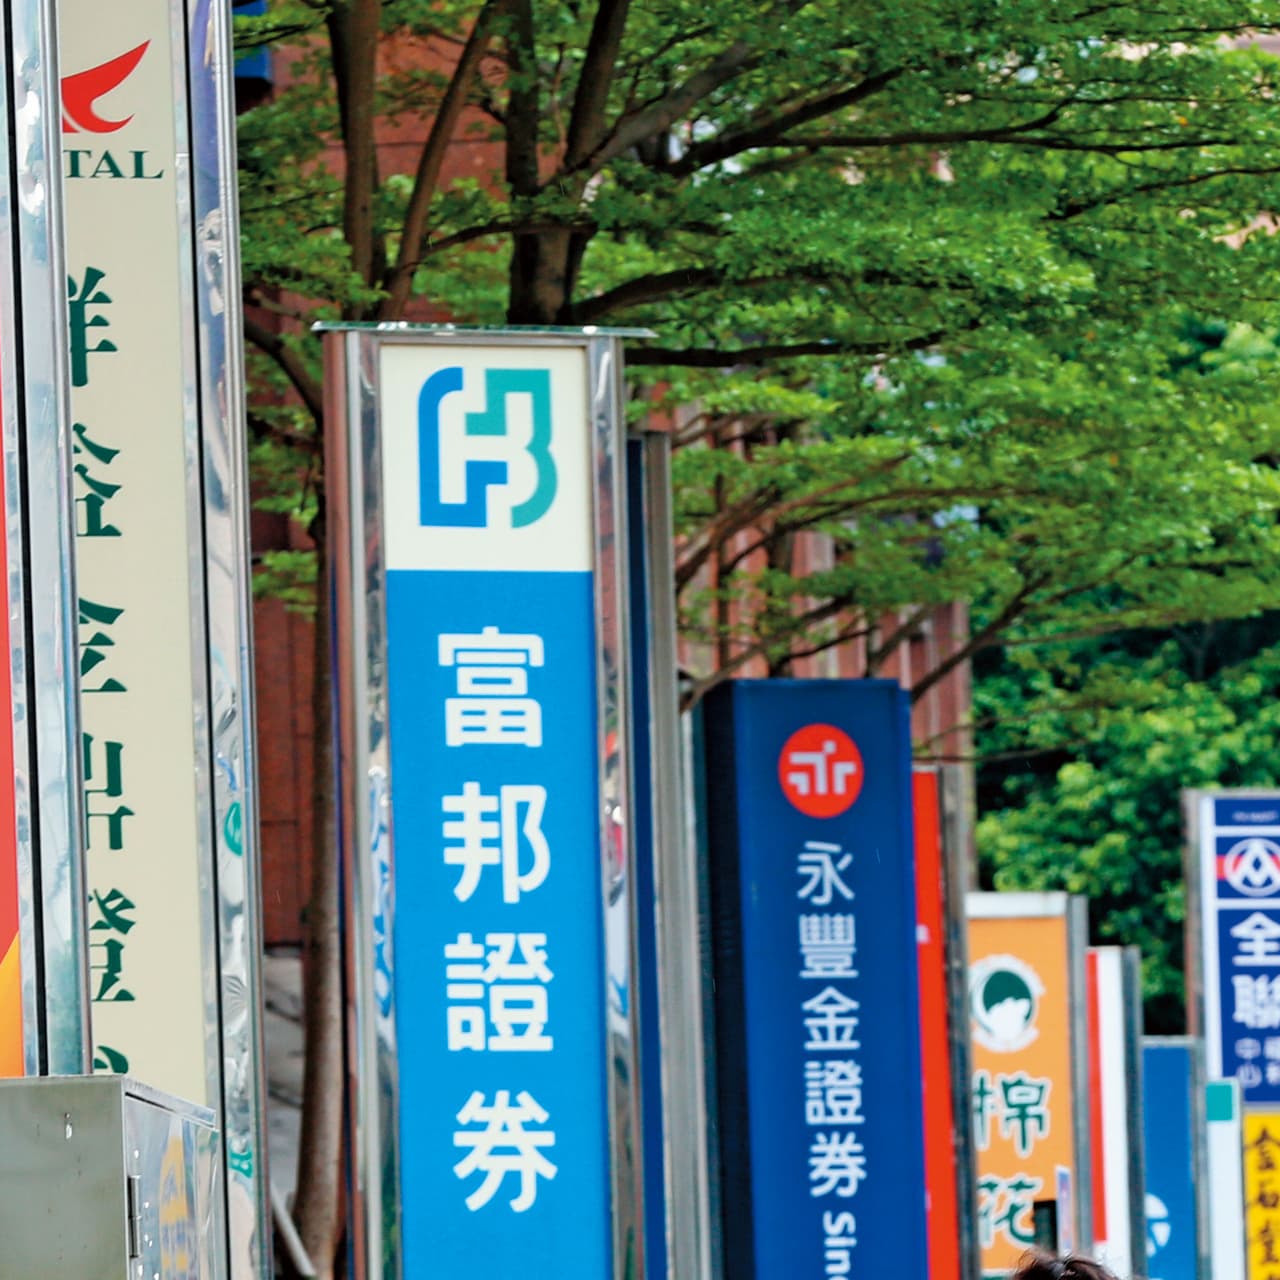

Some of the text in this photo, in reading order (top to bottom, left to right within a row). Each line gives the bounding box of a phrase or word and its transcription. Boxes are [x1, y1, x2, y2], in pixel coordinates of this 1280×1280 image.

[437, 626, 558, 1213] 富邦證券
[796, 841, 867, 1197] 永豐金證券
